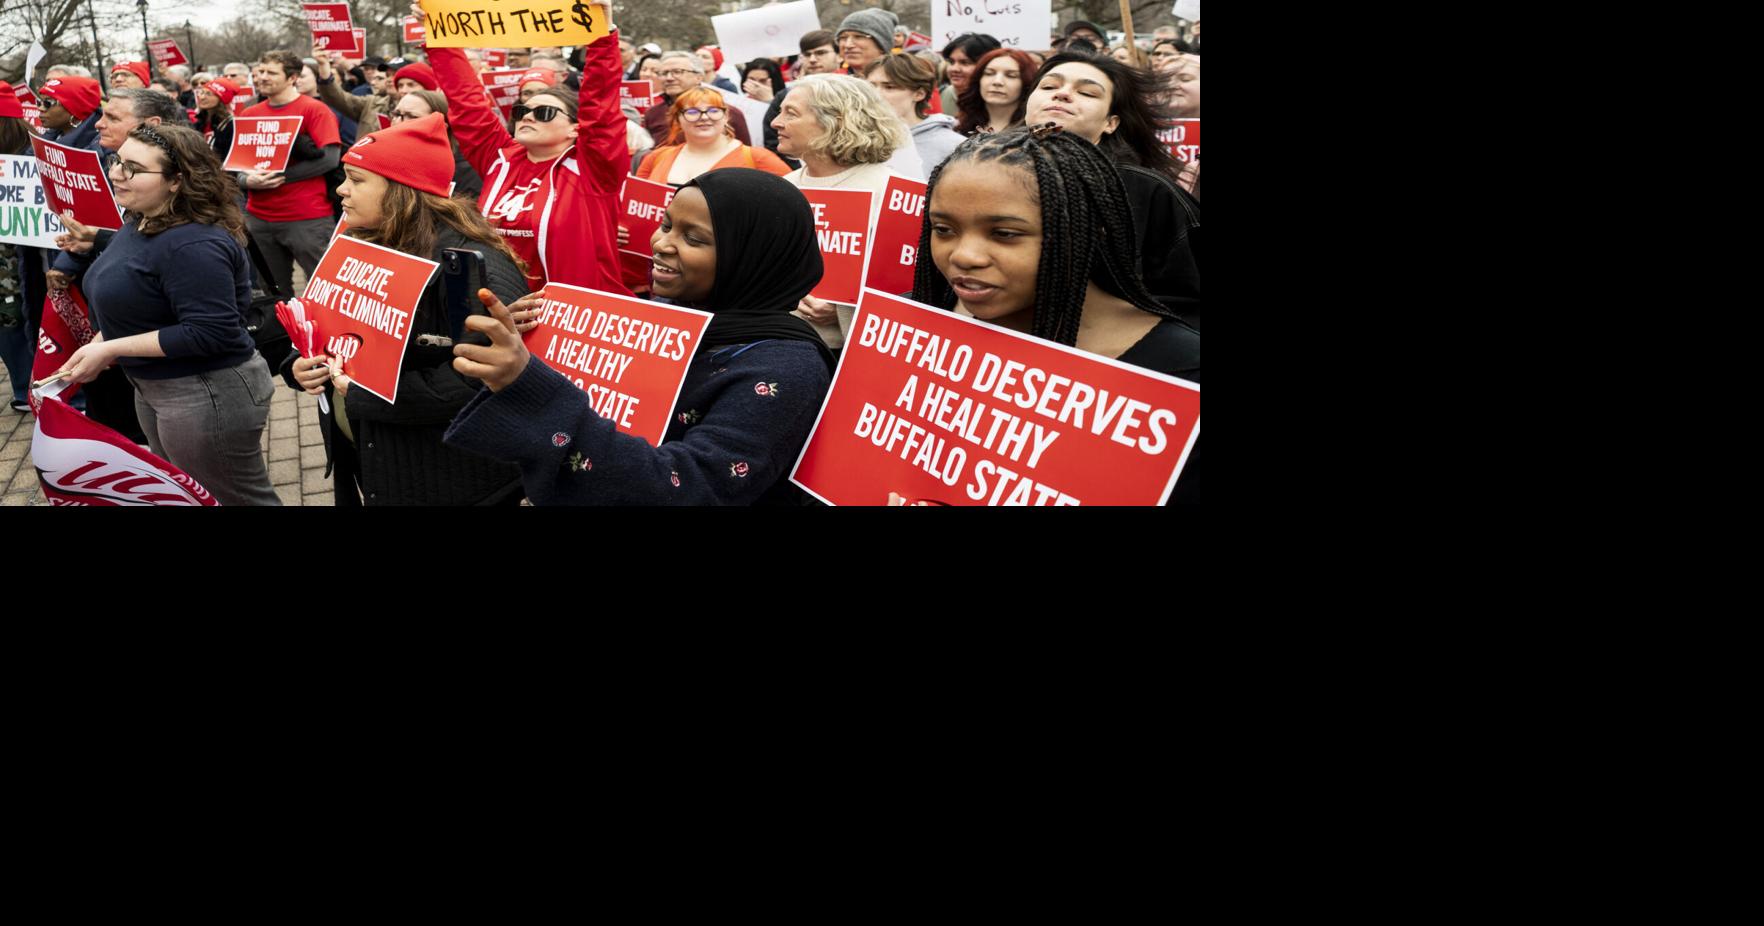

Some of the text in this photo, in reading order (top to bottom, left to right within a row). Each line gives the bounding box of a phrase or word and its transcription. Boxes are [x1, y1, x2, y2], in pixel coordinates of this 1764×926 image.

[427, 10, 506, 40] WORTH
[510, 9, 564, 33] THE
[238, 133, 273, 145] BUFFALO
[257, 121, 279, 133] FUND
[44, 145, 67, 168] FUND
[256, 145, 276, 158] NOW
[54, 183, 74, 205] NOW
[65, 171, 101, 192] STATE
[336, 256, 394, 301] EDUCATE,
[307, 277, 408, 340] DON'T ELIMINATE
[537, 299, 690, 361] UFFALO DESERVES
[545, 334, 558, 361] A
[556, 338, 633, 384] HEALTHY
[860, 313, 1177, 455] BUFFALO DESERVES
[895, 375, 1060, 469] A HEALTHY
[853, 402, 967, 487] BUFFALO
